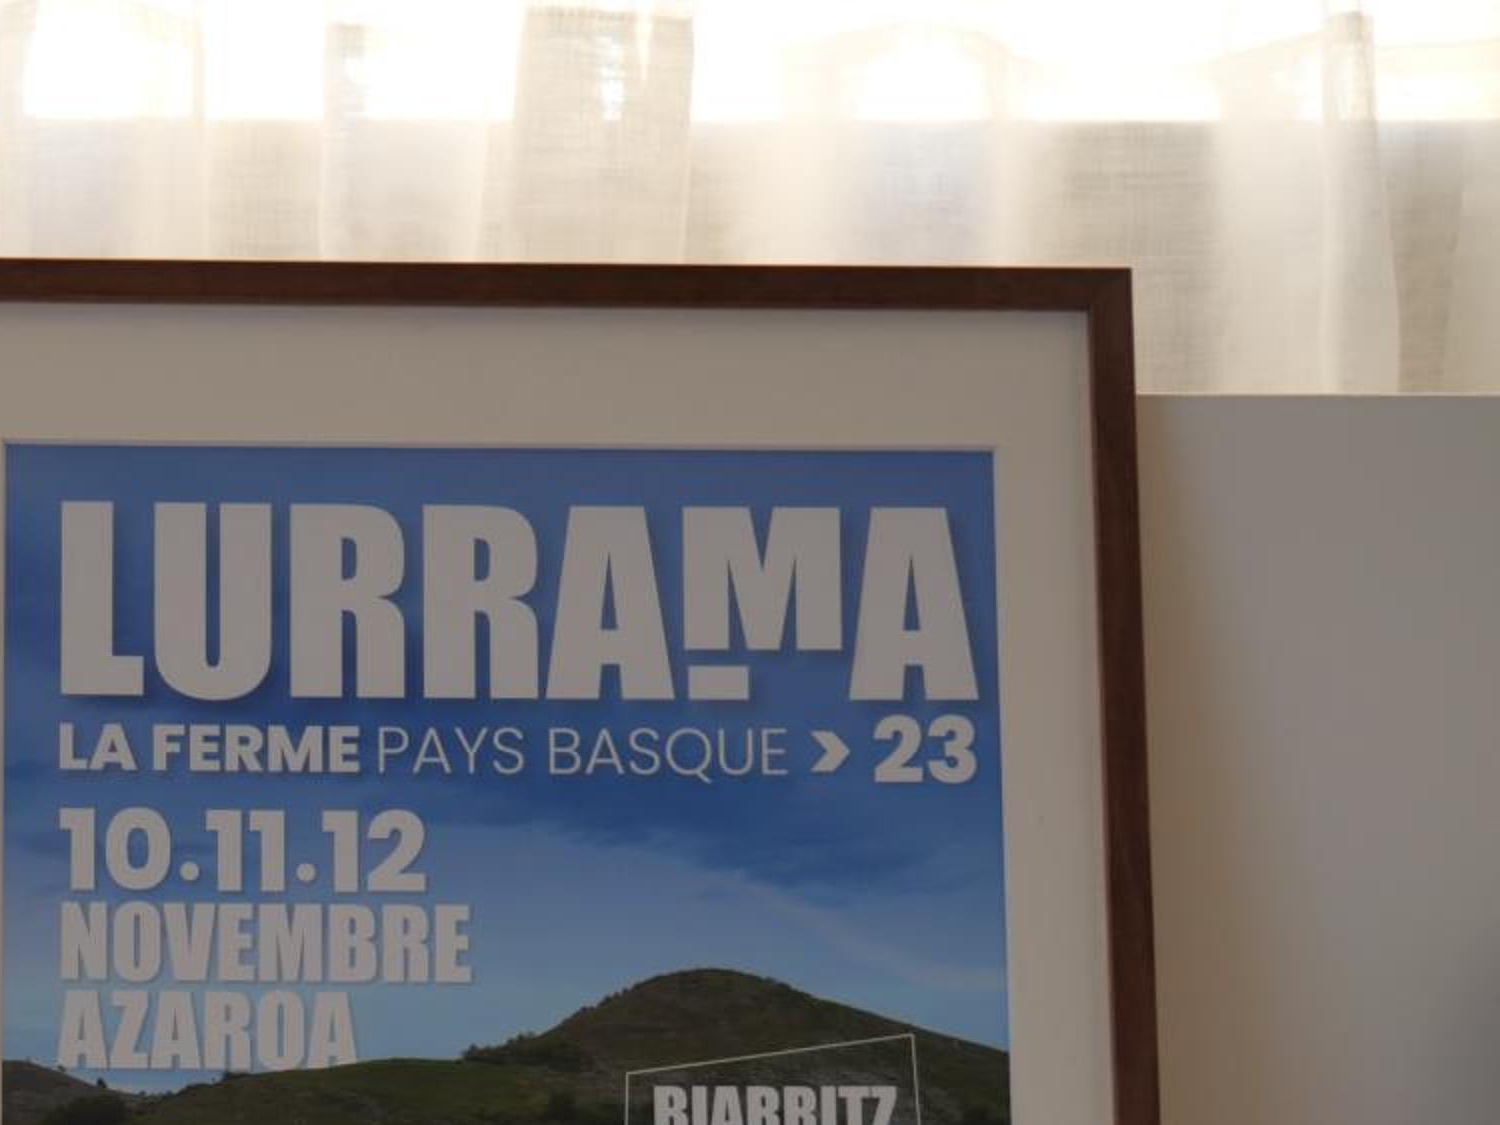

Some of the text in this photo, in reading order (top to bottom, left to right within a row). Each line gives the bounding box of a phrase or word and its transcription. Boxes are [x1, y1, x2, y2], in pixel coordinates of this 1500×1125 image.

[59, 500, 980, 701] LURRAMA
[58, 713, 979, 784] LA FERME PAYS BASQUE 23
[58, 806, 428, 894] 10.11.12
[59, 901, 473, 984] NOVEMBRE
[56, 989, 358, 1071] AZAROA
